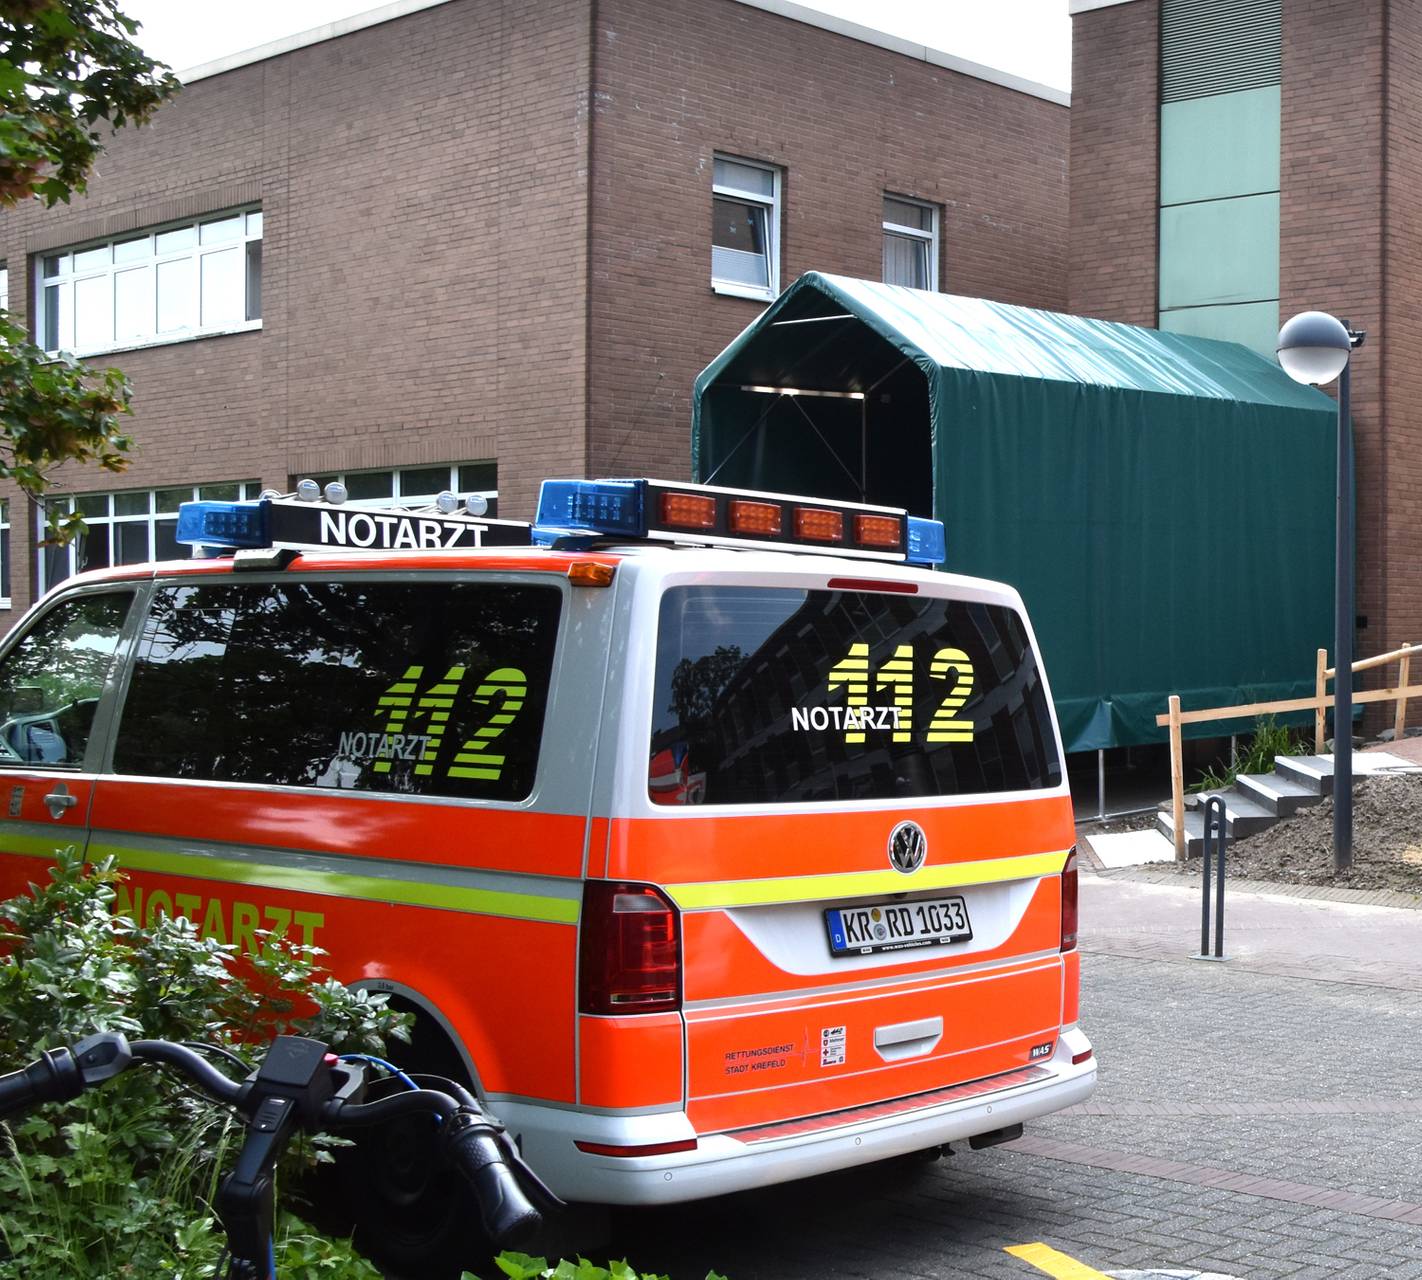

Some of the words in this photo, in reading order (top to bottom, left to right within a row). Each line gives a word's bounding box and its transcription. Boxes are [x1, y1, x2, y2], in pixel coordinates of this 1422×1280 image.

[320, 511, 488, 549] NOTARZT
[826, 643, 974, 743] 112
[374, 665, 527, 780] 112
[791, 706, 902, 731] NOTARZT
[338, 731, 432, 761] NOTARZT
[843, 910, 873, 943] KR
[886, 907, 914, 938] RD
[917, 902, 965, 935] 1033
[725, 1044, 794, 1061] RETTUNGSDIENST
[726, 1065, 749, 1075] STADT
[751, 1060, 786, 1070] KREFELD
